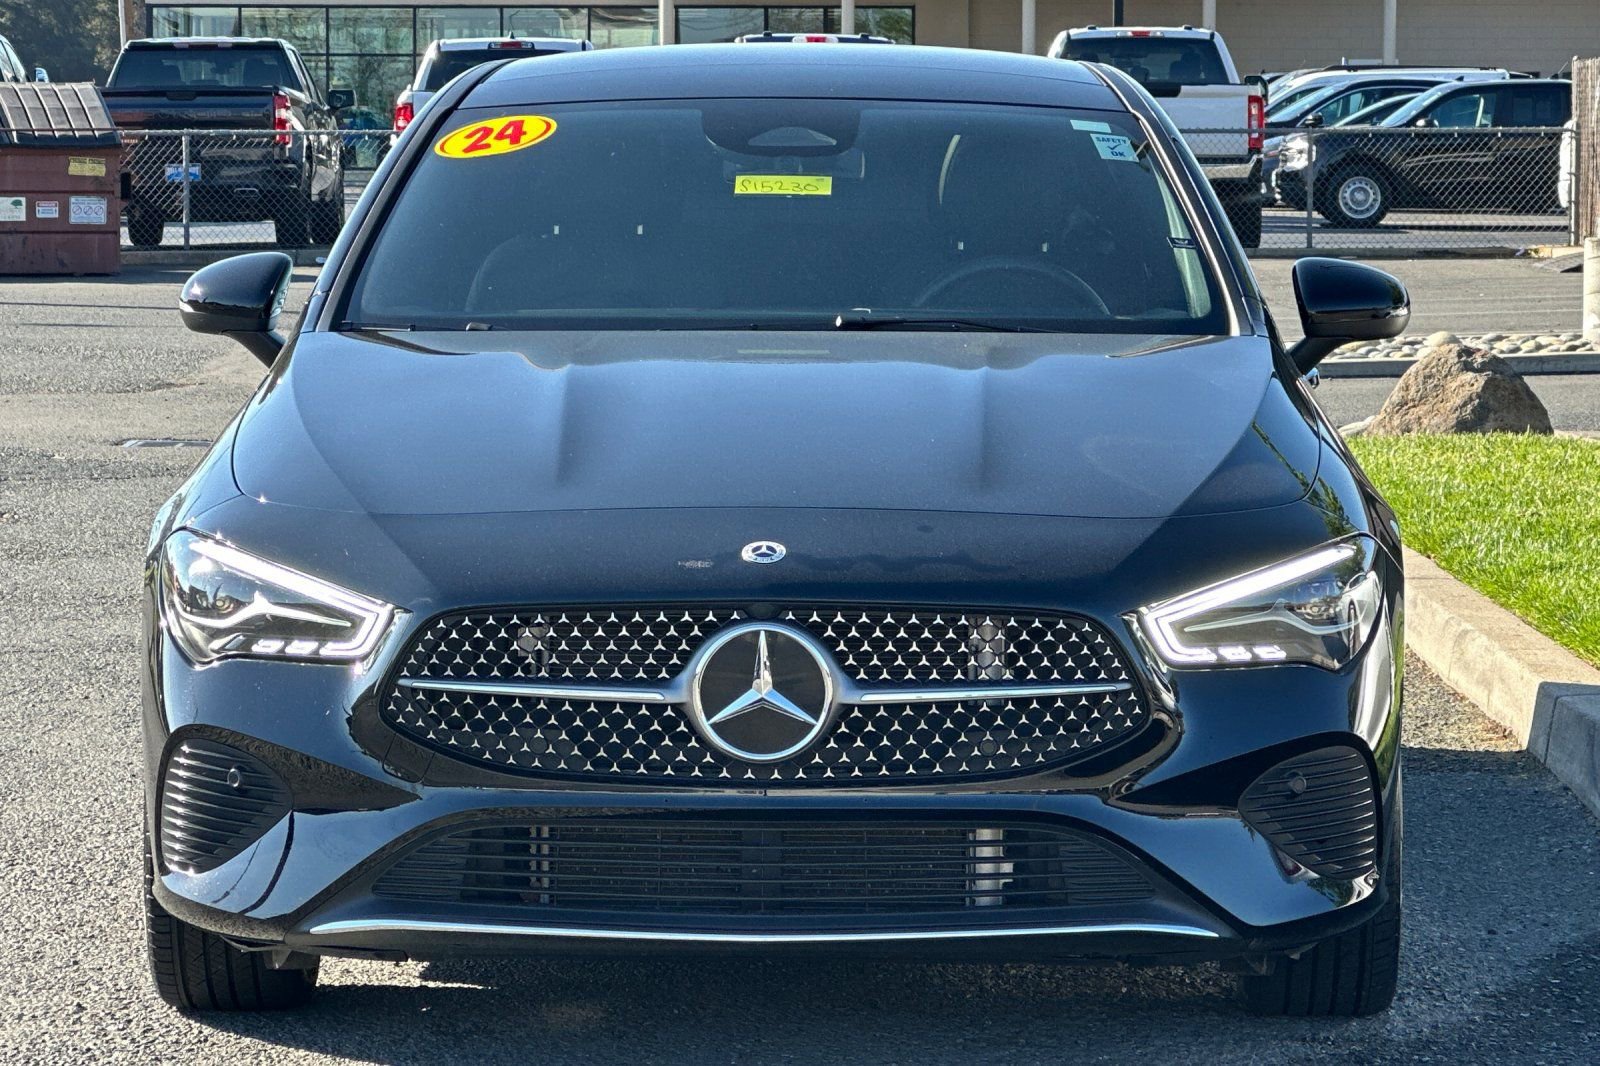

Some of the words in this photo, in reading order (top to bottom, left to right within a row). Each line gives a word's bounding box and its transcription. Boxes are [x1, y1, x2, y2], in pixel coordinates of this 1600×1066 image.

[462, 119, 527, 154] 24
[1095, 136, 1127, 144] SAFETY
[739, 178, 819, 193] S15230
